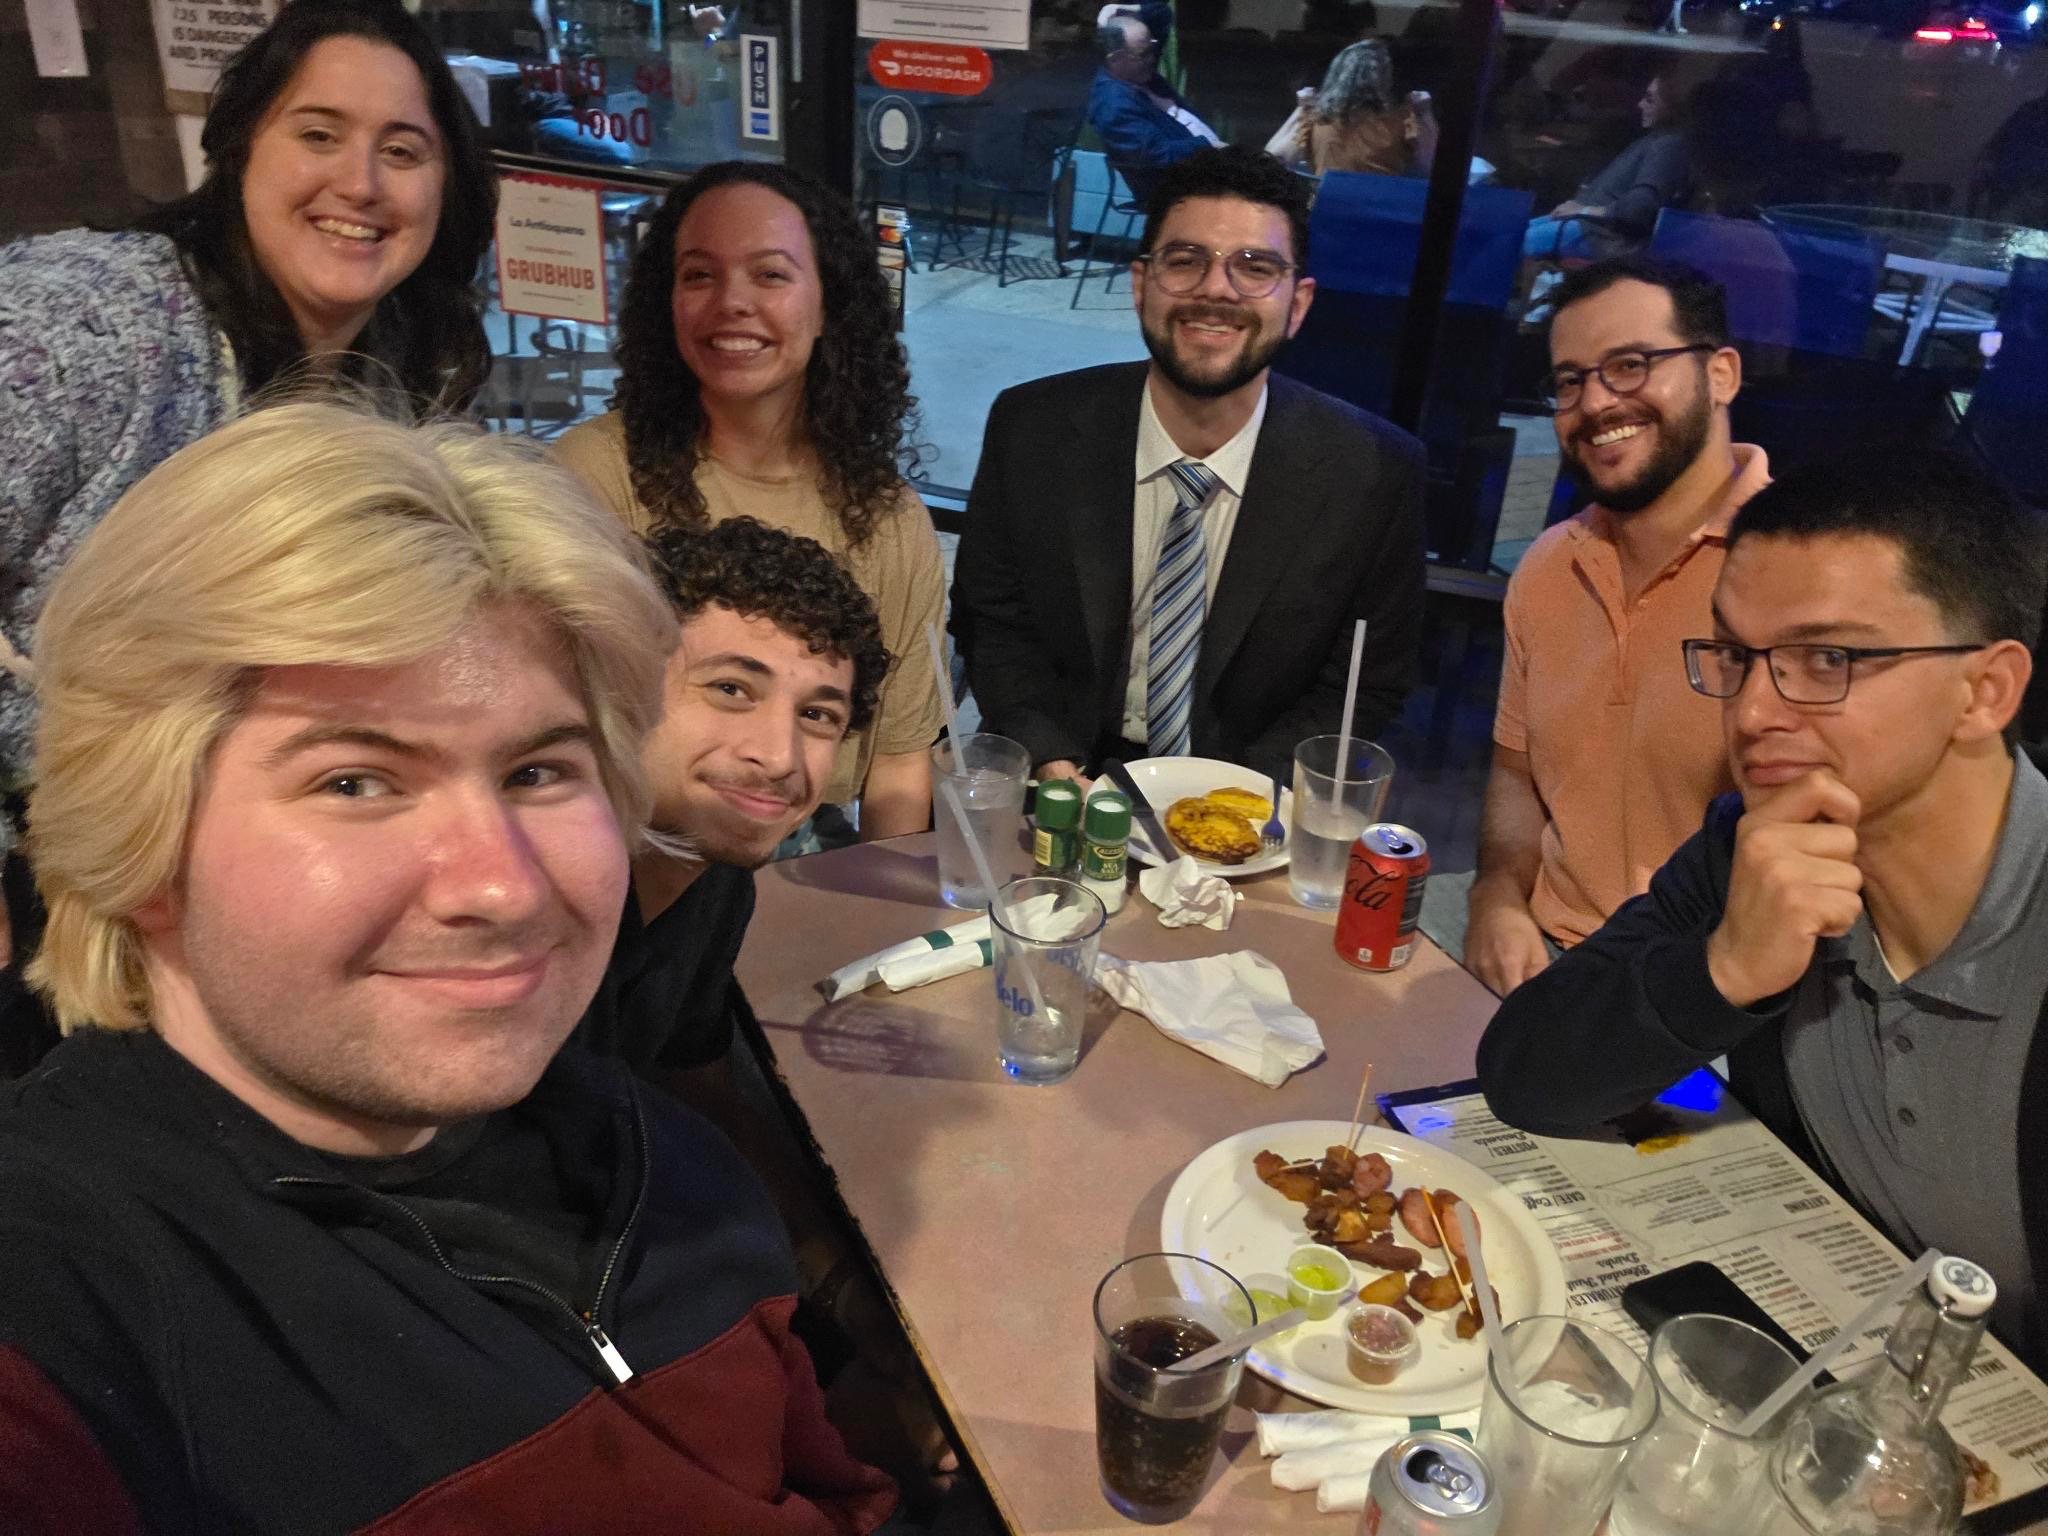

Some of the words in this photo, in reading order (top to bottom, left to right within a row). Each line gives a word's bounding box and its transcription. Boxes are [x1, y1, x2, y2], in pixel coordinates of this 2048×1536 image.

[753, 44, 767, 104] PUSH
[903, 64, 982, 82] DOORDASH
[506, 256, 596, 291] GRUBHUB
[1595, 1252, 1641, 1269] Drinks
[1597, 1264, 1650, 1286] Blended
